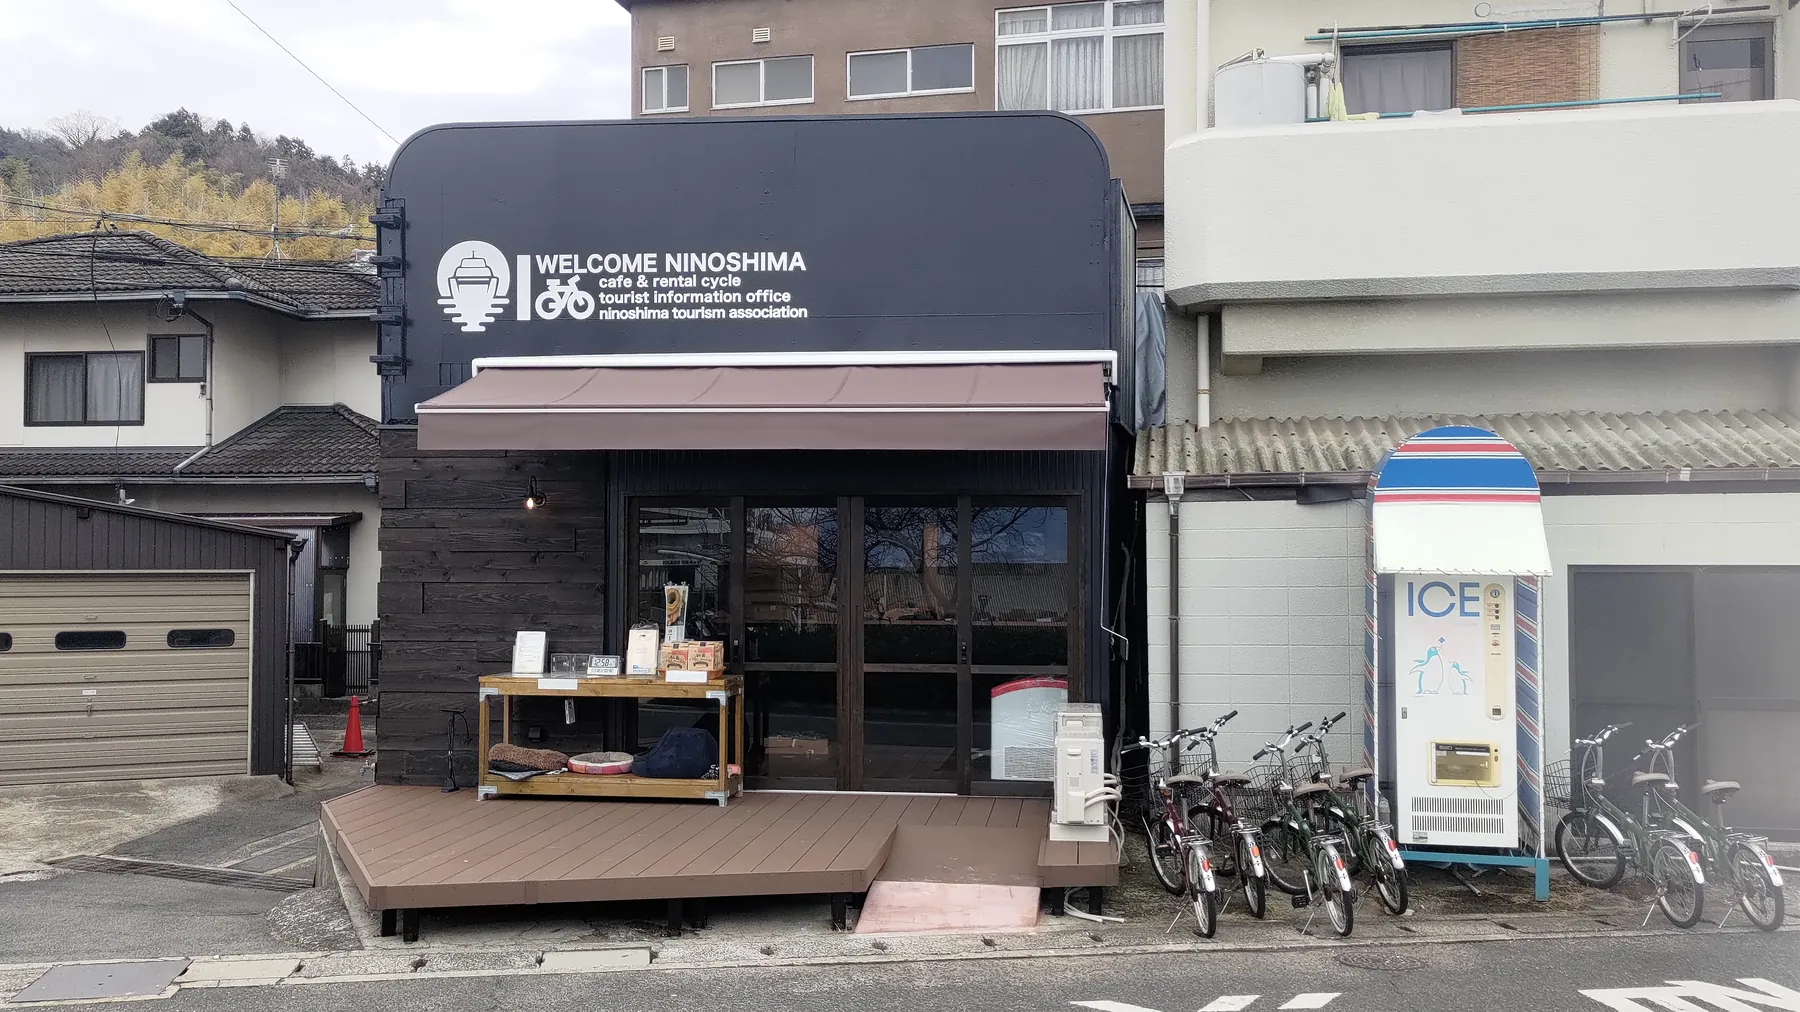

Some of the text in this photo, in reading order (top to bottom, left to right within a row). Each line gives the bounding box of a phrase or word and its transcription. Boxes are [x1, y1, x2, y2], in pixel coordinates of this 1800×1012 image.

[535, 251, 807, 274] WELCOME NINOSHIMA
[598, 273, 742, 289] cafe & rental cycle
[598, 289, 792, 305] tourist information office
[599, 304, 808, 320] ninoshima tourism association
[1407, 581, 1481, 618] ICE
